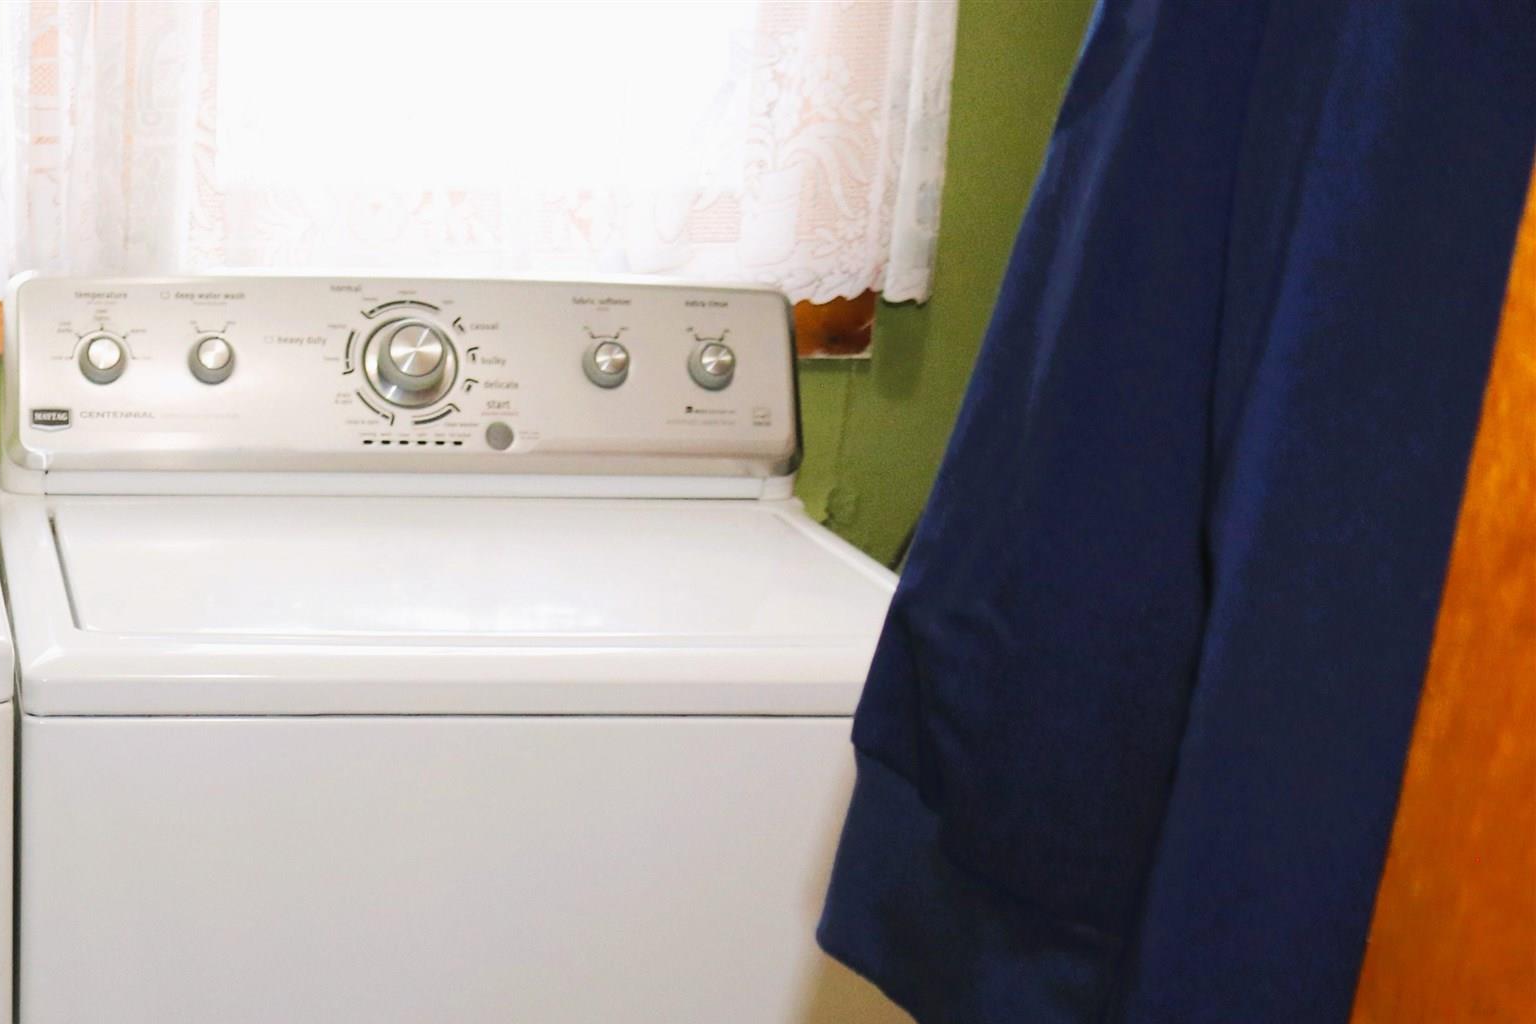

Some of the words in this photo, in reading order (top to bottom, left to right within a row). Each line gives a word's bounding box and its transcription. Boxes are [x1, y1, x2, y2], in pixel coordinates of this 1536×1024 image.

[74, 290, 128, 300] temperature
[175, 291, 195, 301] deep
[197, 291, 221, 299] water
[223, 291, 245, 299] wash
[277, 336, 305, 346] heavy
[306, 336, 327, 346] duty
[481, 356, 507, 367] bulky
[484, 379, 519, 389] delicate
[486, 400, 511, 409] start
[79, 410, 156, 419] CENTENNIAL
